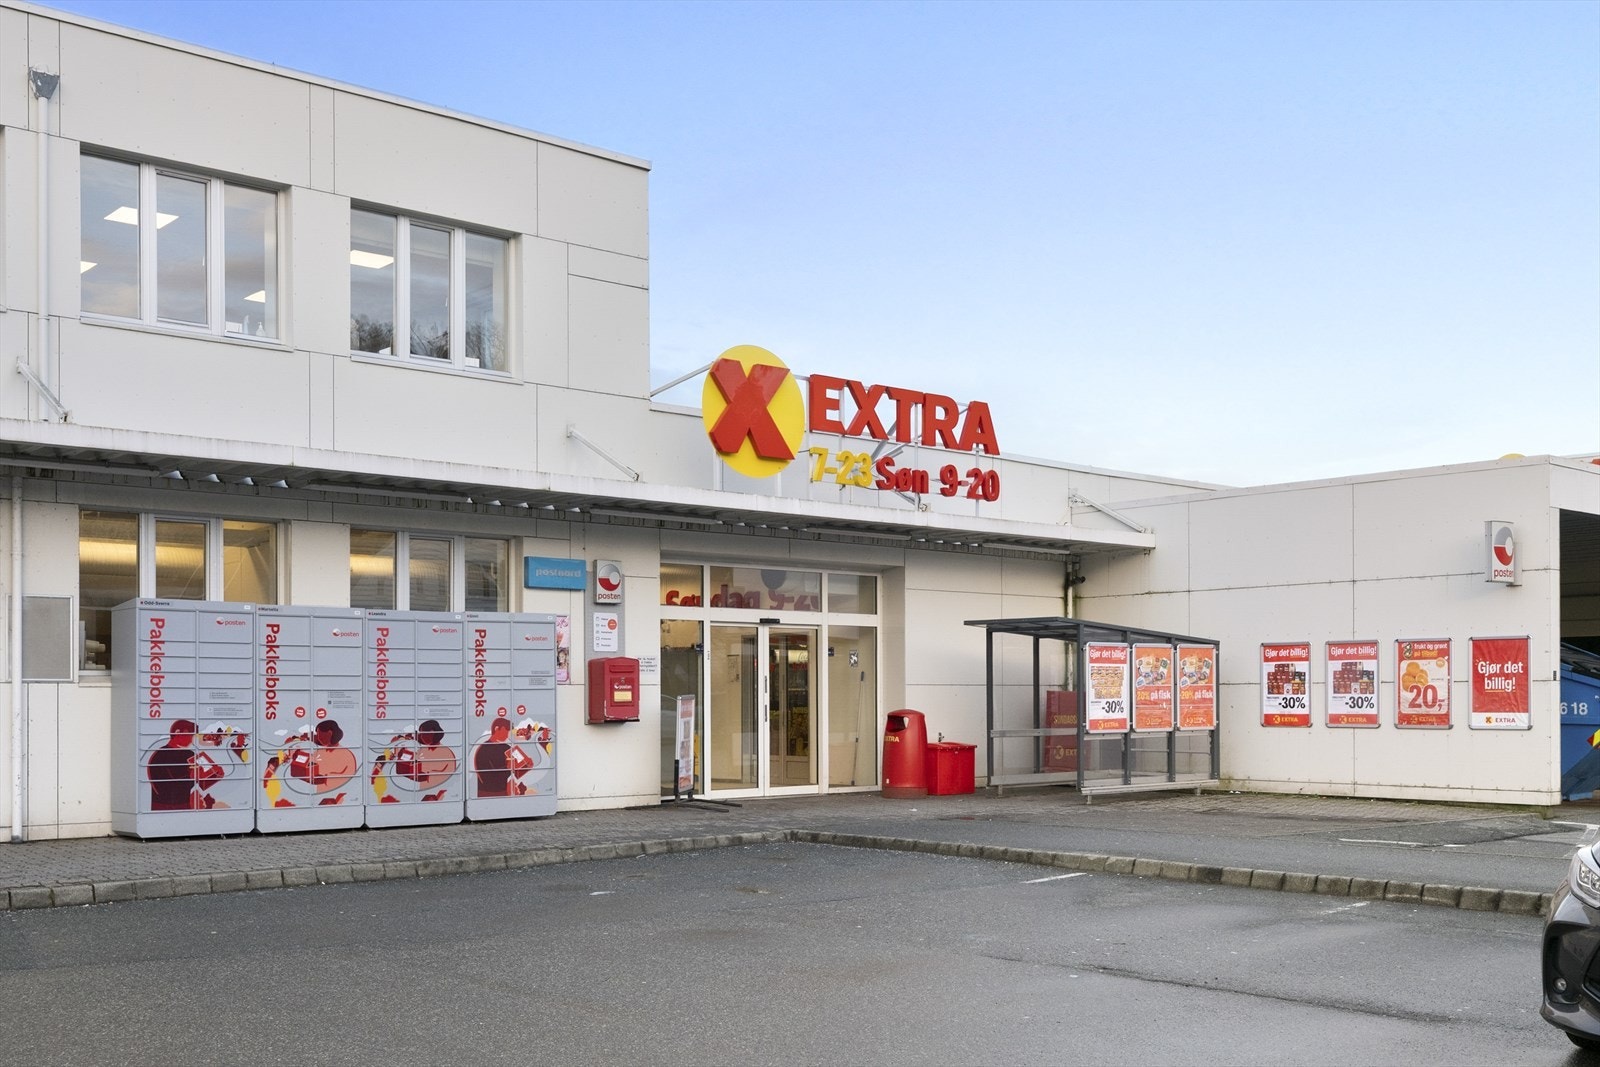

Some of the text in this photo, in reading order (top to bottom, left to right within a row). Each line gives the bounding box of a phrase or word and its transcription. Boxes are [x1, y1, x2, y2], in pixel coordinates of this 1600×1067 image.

[809, 374, 1000, 455] EXTRA
[809, 447, 873, 487] 7-23
[875, 456, 1000, 502] Søn 9-20
[597, 592, 621, 600] posten
[225, 619, 246, 627] posten
[1089, 649, 1126, 660] Gjør det billig!
[1265, 648, 1308, 659] Gjør det billig!
[1331, 646, 1377, 657] Gjør det billig!
[149, 617, 165, 718] Pakkeboks
[265, 623, 280, 720] Pakkeboks
[376, 627, 390, 719] Pakkeboks
[474, 629, 487, 718] Pakkeboks
[1478, 661, 1523, 677] Gjør det
[1484, 677, 1516, 692] billig!
[1150, 690, 1158, 701] på
[1158, 690, 1171, 699] fisk
[1202, 690, 1213, 699] fisk
[1102, 700, 1124, 713] -30%
[1278, 697, 1306, 709] -30%
[1345, 696, 1375, 709] -30%
[1571, 702, 1588, 715] 18
